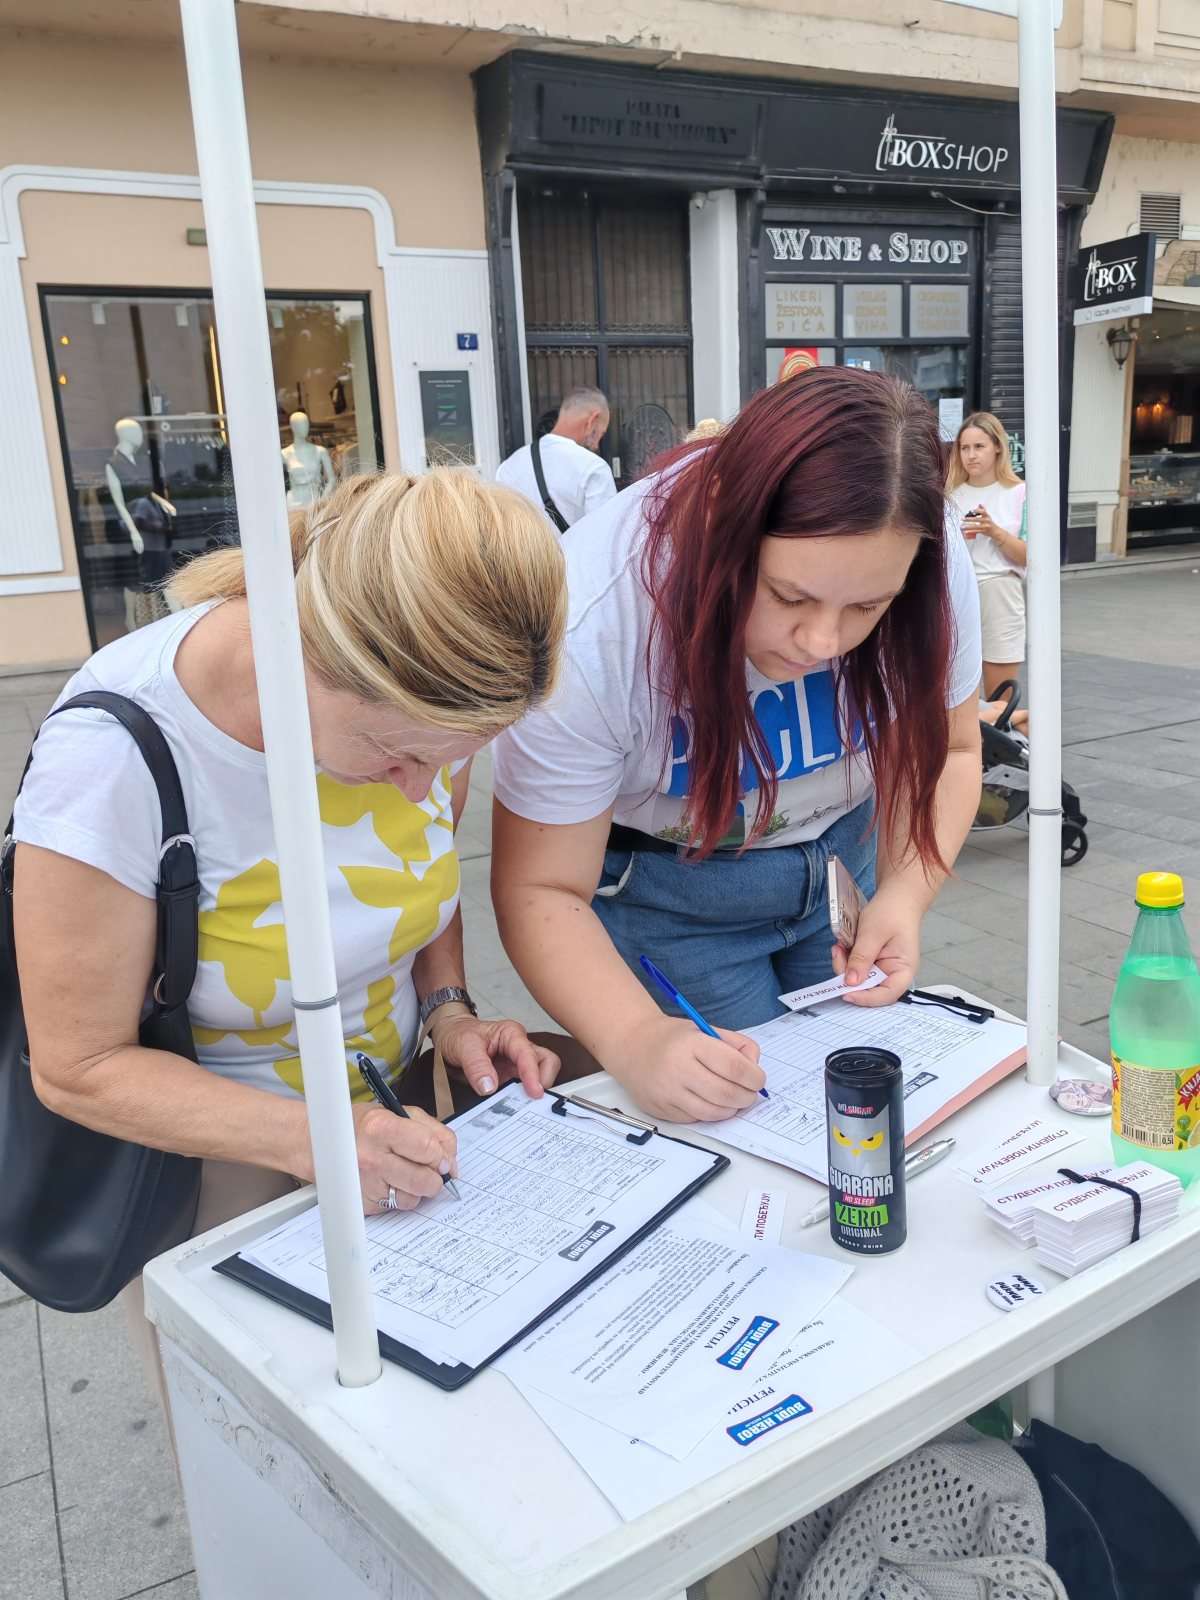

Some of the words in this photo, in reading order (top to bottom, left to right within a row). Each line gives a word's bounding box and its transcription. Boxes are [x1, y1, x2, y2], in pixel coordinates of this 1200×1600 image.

[868, 243, 883, 261] &
[888, 232, 969, 264] SHOP
[1098, 261, 1138, 289] BOX
[776, 289, 823, 303] LIKERI
[1096, 282, 1137, 297] SHOP
[463, 334, 471, 348] 7
[1180, 1071, 1200, 1097] KNJA
[829, 1165, 894, 1198] GUARANA
[997, 1184, 1055, 1204] СТУДЕНТИ
[1053, 1187, 1101, 1213] СТУДЕНТИ
[839, 1204, 882, 1228] ZERO
[840, 1225, 883, 1238] ORIGINAL
[704, 1316, 741, 1350] PETICIJA
[750, 1320, 774, 1342] BUDI
[727, 1340, 757, 1367] HEROJ
[774, 1401, 807, 1421] BUDI
[736, 1416, 777, 1442] HEROJ
